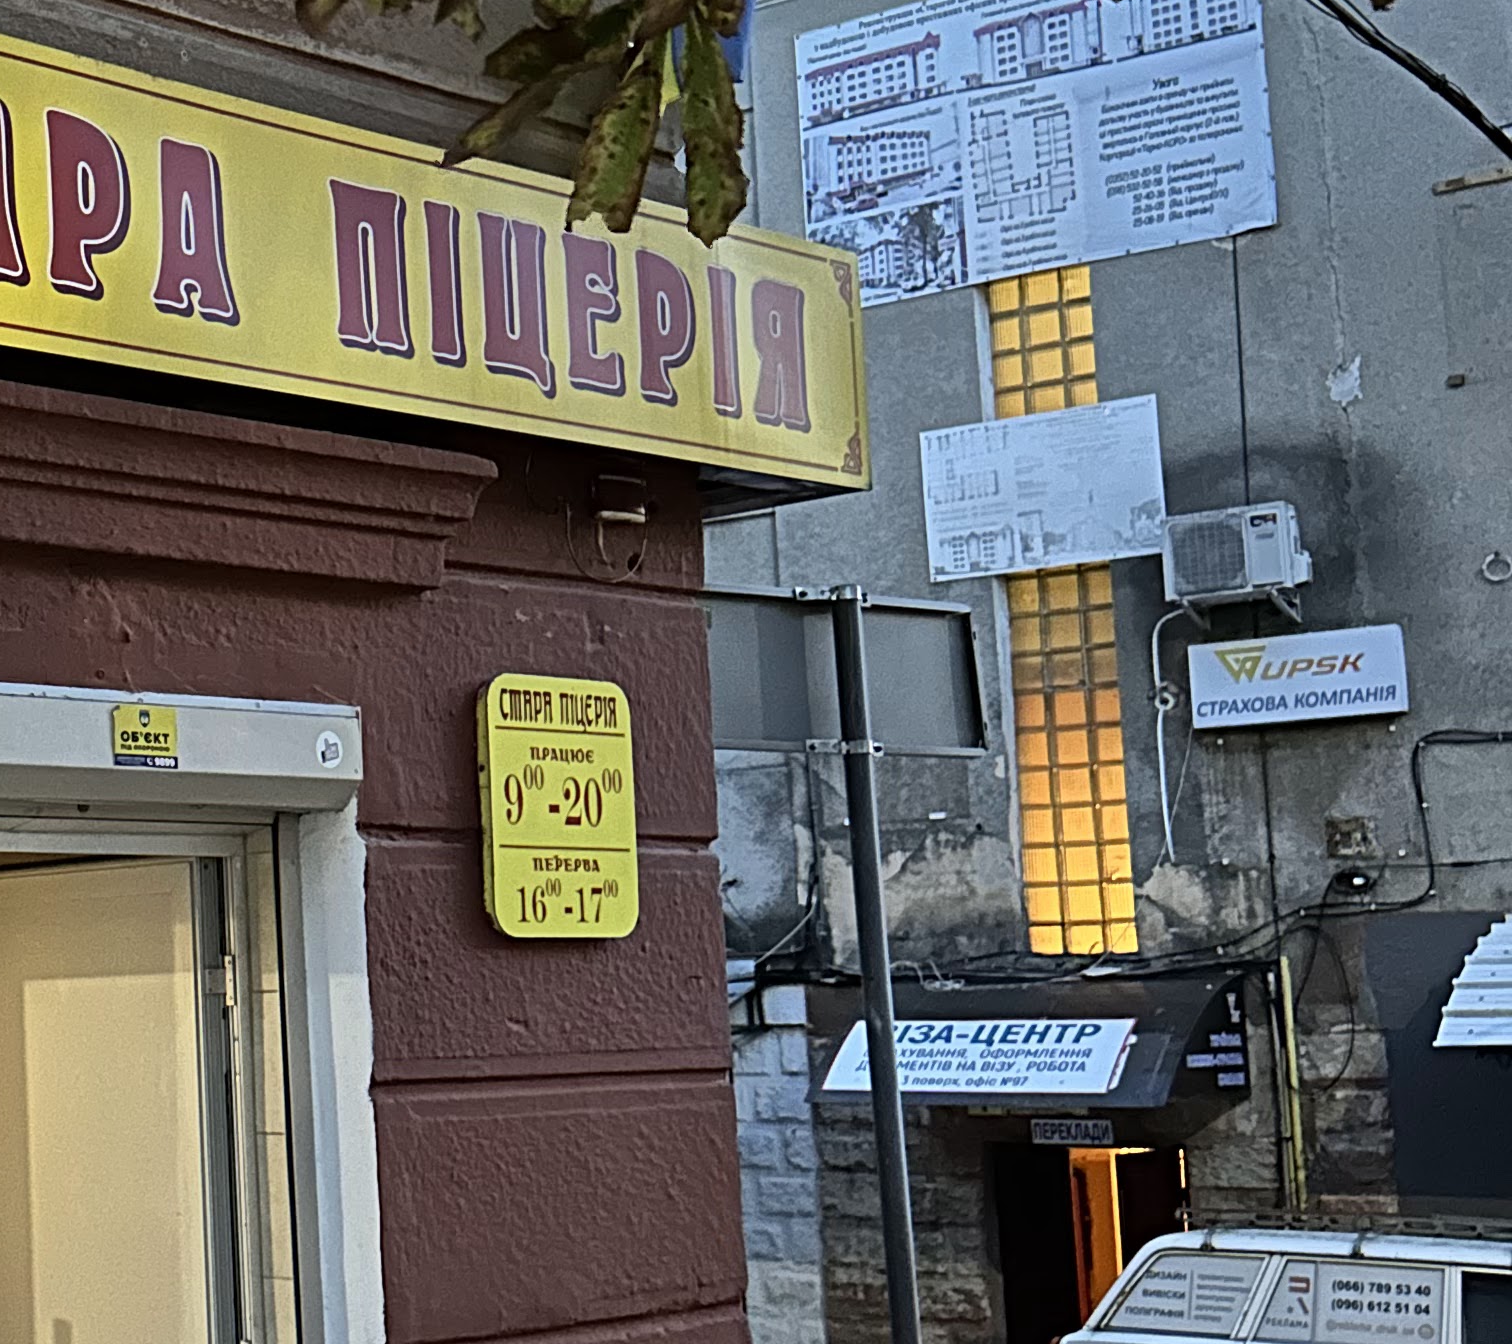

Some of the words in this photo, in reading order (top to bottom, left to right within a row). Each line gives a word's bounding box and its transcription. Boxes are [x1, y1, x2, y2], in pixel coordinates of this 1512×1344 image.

[329, 178, 811, 432] ПІЦЕРІЯ
[1261, 652, 1365, 681] UPSK
[1197, 693, 1287, 717] СТРАХОВА
[1294, 684, 1397, 709] КОМПАНІЯ
[499, 688, 553, 723] СТАРА
[559, 692, 617, 732] ПІЦЕРІЯ
[120, 730, 170, 744] ОБ'ЄКТ
[530, 747, 594, 764] ПРАЦЮЄ
[533, 855, 600, 873] ПЕРЕРВА
[894, 1023, 1102, 1047] ІЗА-ЦЕНТР
[979, 1047, 1093, 1059] ОФОРМЛЕННЯ
[854, 1059, 953, 1072] ДМЕНТІВ
[955, 1060, 976, 1071] НА
[1026, 1060, 1087, 1072] РОБОТА
[1034, 1121, 1112, 1143] ПЕРЕКЛАДИ
[1331, 1279, 1365, 1295] (066)
[1369, 1282, 1392, 1294] 789
[1395, 1285, 1412, 1296] 53
[1414, 1285, 1432, 1297] 40
[1331, 1299, 1364, 1314] (096)
[1367, 1301, 1391, 1313] 612
[1394, 1303, 1410, 1315] 51
[1413, 1306, 1431, 1316] 04
